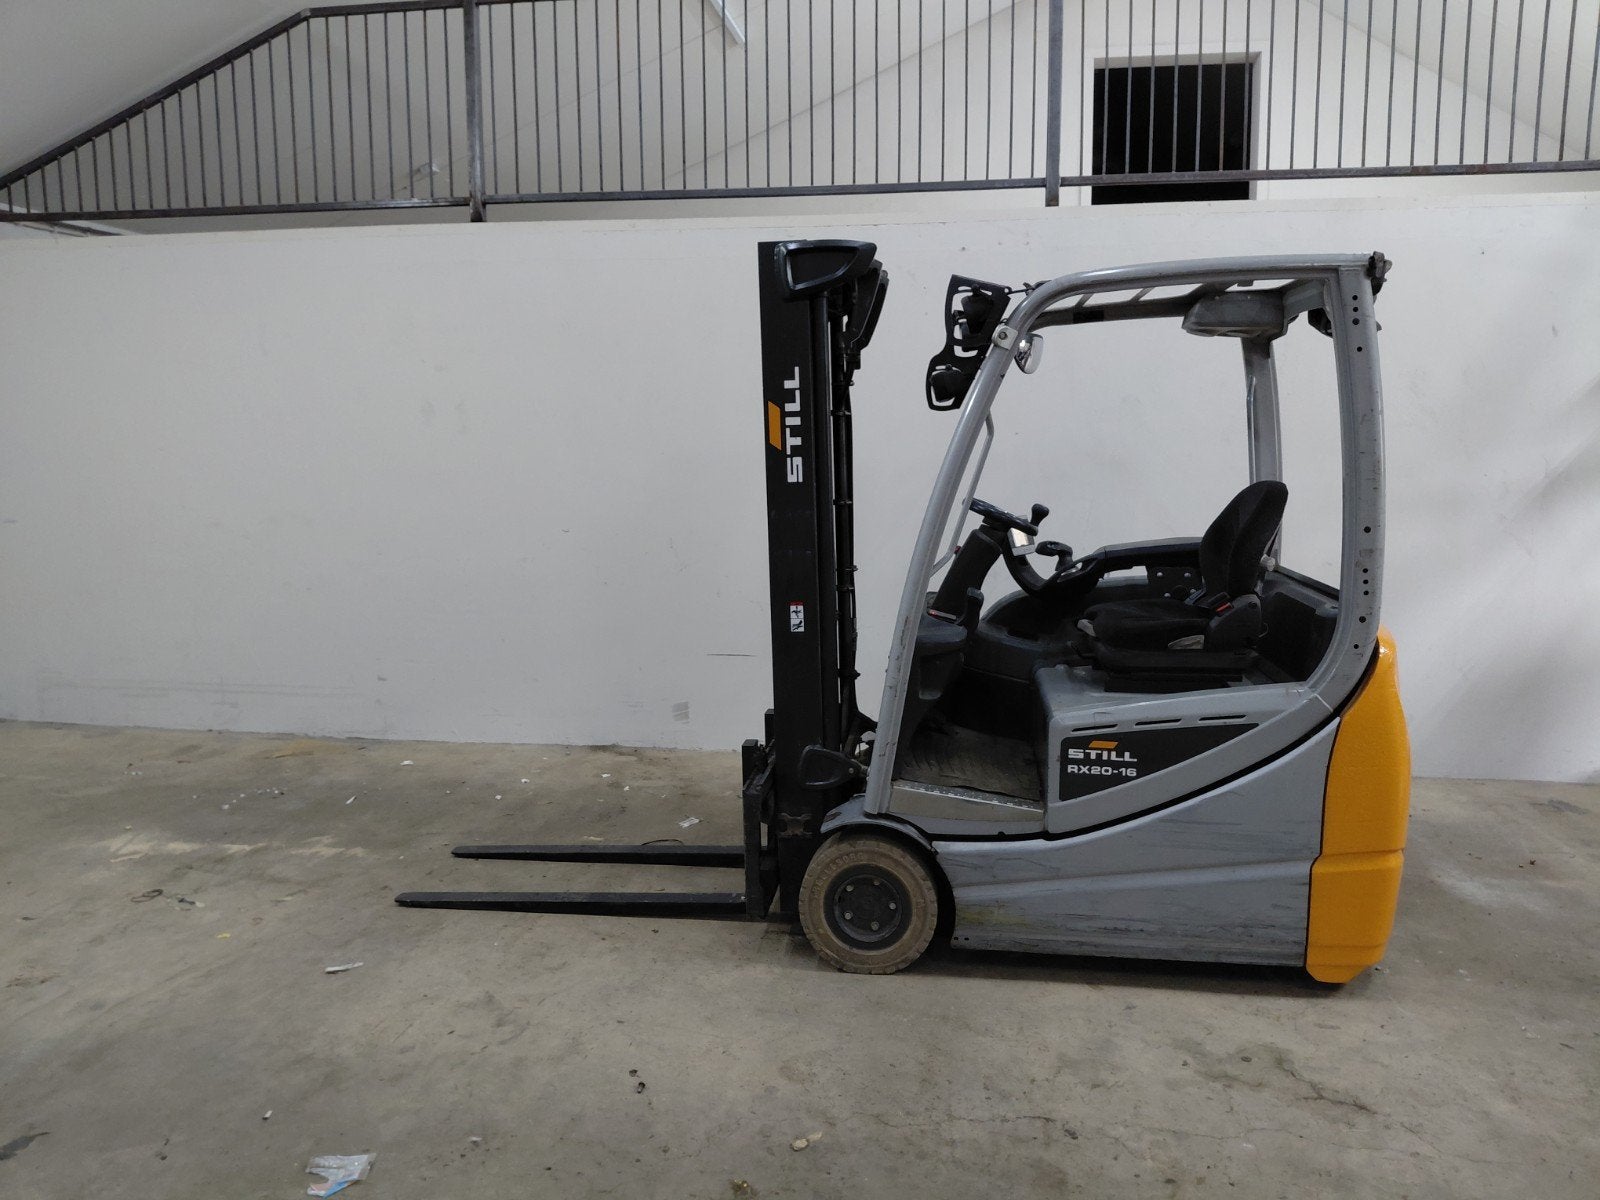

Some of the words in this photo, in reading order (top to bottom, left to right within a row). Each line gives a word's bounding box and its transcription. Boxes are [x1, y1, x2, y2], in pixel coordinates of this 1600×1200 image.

[783, 366, 803, 483] STILL
[1067, 748, 1138, 762] STILL
[1067, 764, 1137, 777] RX20-16
